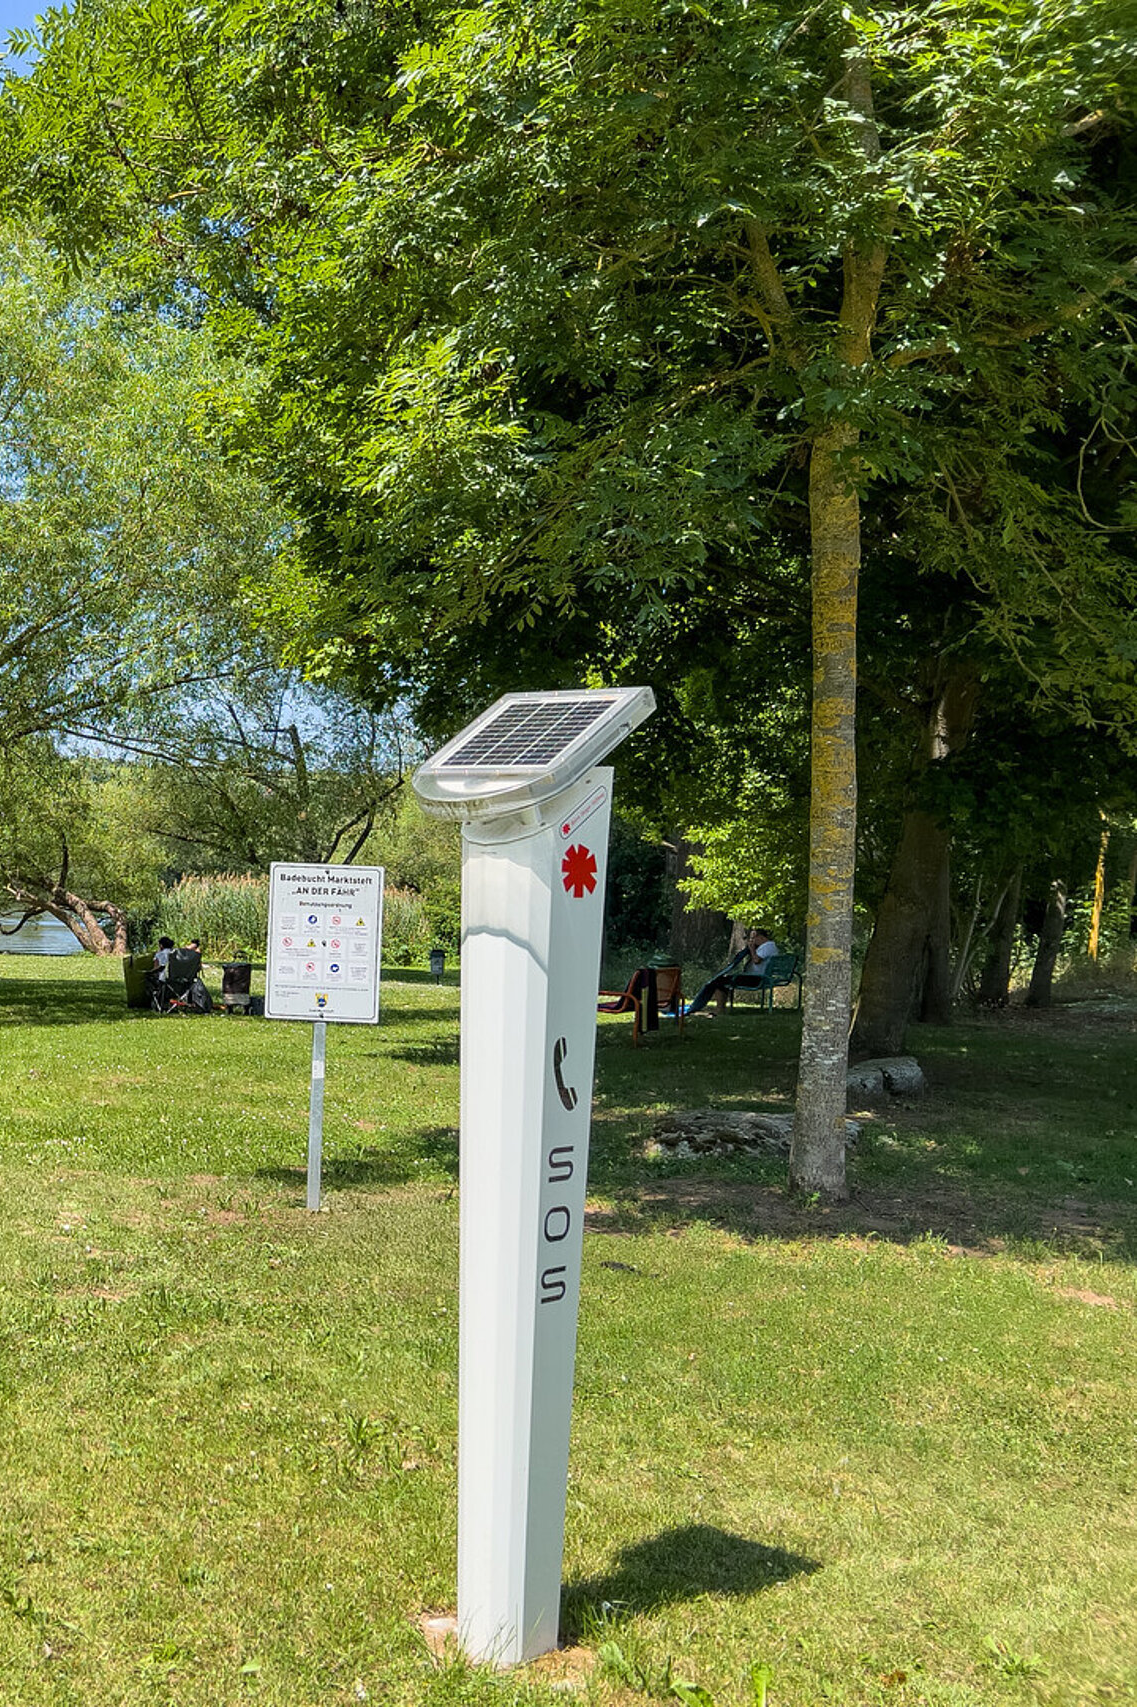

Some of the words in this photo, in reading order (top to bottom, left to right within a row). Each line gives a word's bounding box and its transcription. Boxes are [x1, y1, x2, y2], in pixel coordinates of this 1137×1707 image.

[280, 873, 326, 883] Badebucht
[327, 875, 373, 885] Marktsteft
[311, 887, 329, 896] DER
[540, 1145, 574, 1304] SOS
